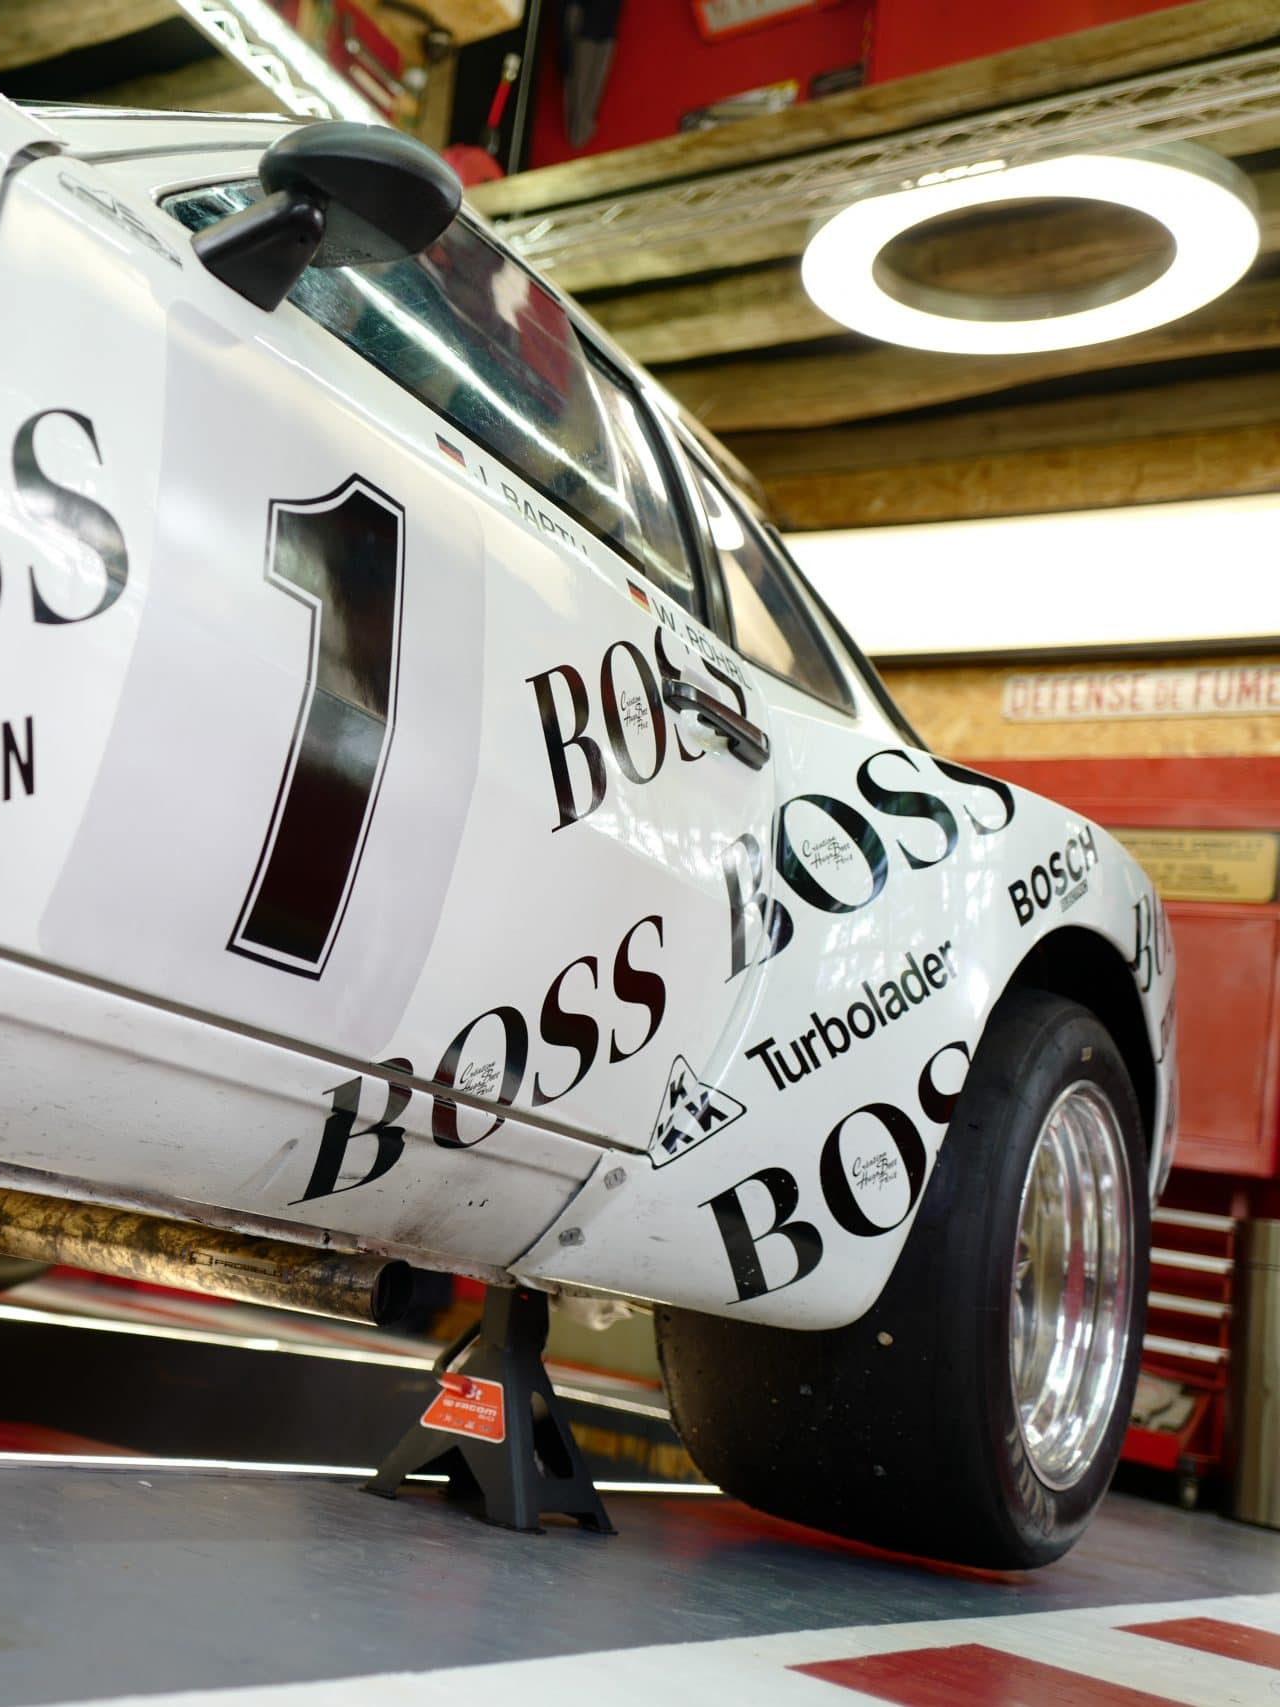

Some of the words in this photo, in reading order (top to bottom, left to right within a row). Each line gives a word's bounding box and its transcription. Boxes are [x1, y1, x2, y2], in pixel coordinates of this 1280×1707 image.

[225, 473, 405, 980] 1
[1008, 825, 1099, 928] BOSCH
[287, 915, 667, 1206] BOSS
[745, 940, 958, 1092] Turbolader
